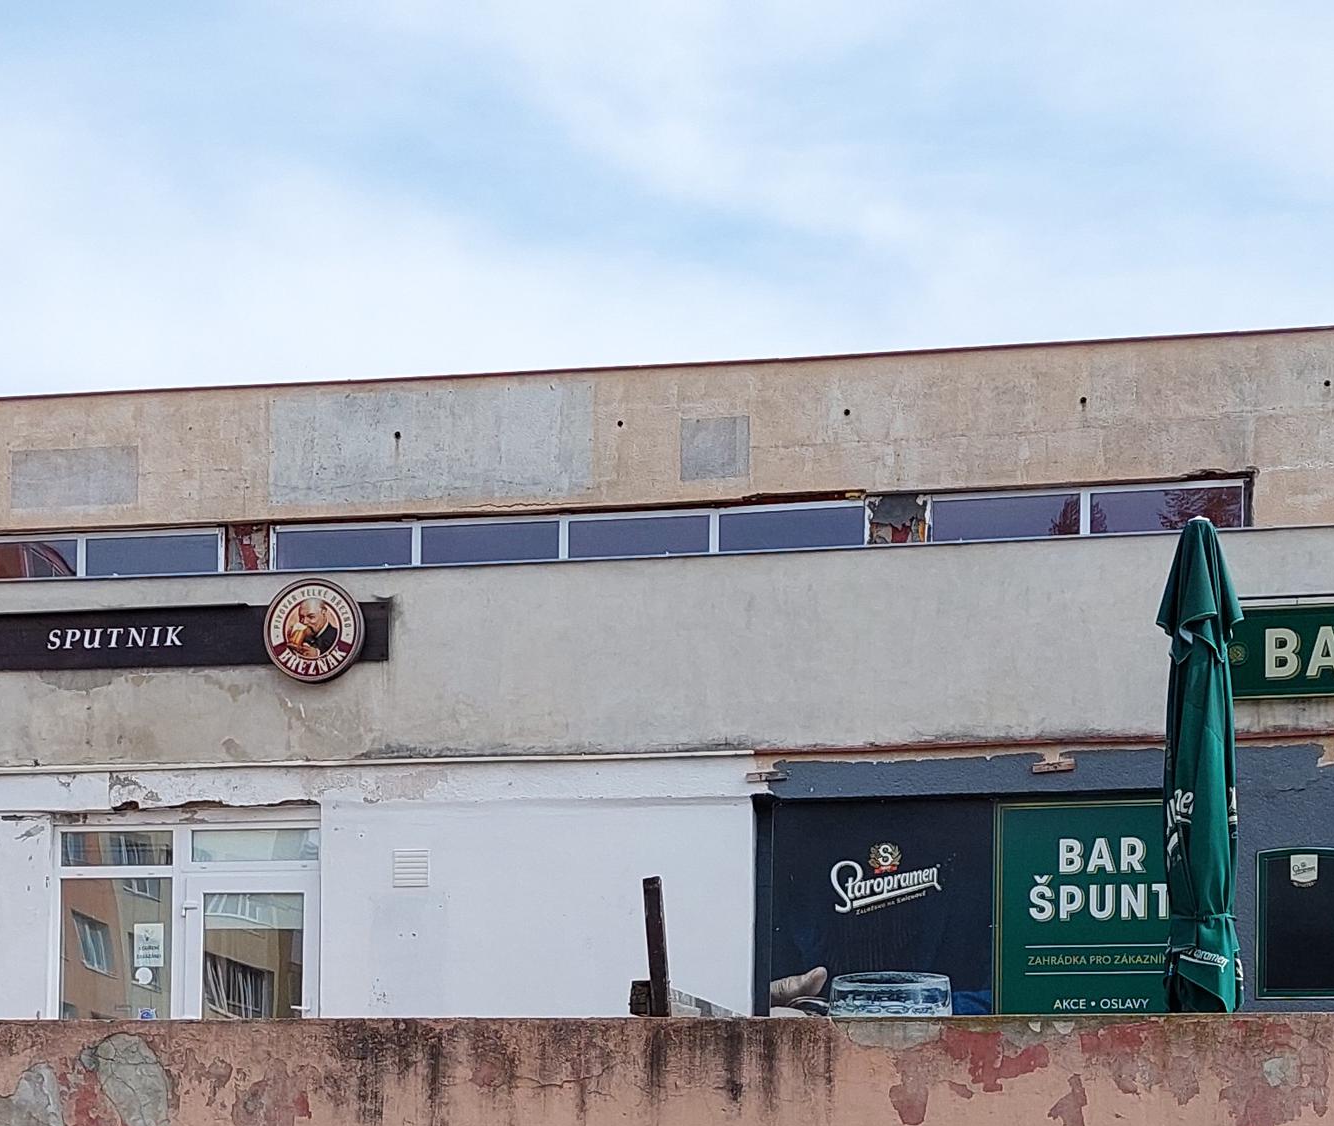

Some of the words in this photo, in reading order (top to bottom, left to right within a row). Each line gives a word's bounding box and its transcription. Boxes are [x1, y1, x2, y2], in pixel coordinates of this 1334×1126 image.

[46, 625, 184, 650] SPUTNIK
[1058, 837, 1147, 875] BAR
[830, 860, 942, 914] Staropramen
[1028, 874, 1169, 922] ŠPUNT
[1028, 953, 1087, 966] ZAHRÁDKA
[1089, 954, 1112, 965] PRO
[1053, 999, 1087, 1010] AKCE
[1099, 998, 1150, 1010] OSLAVY
